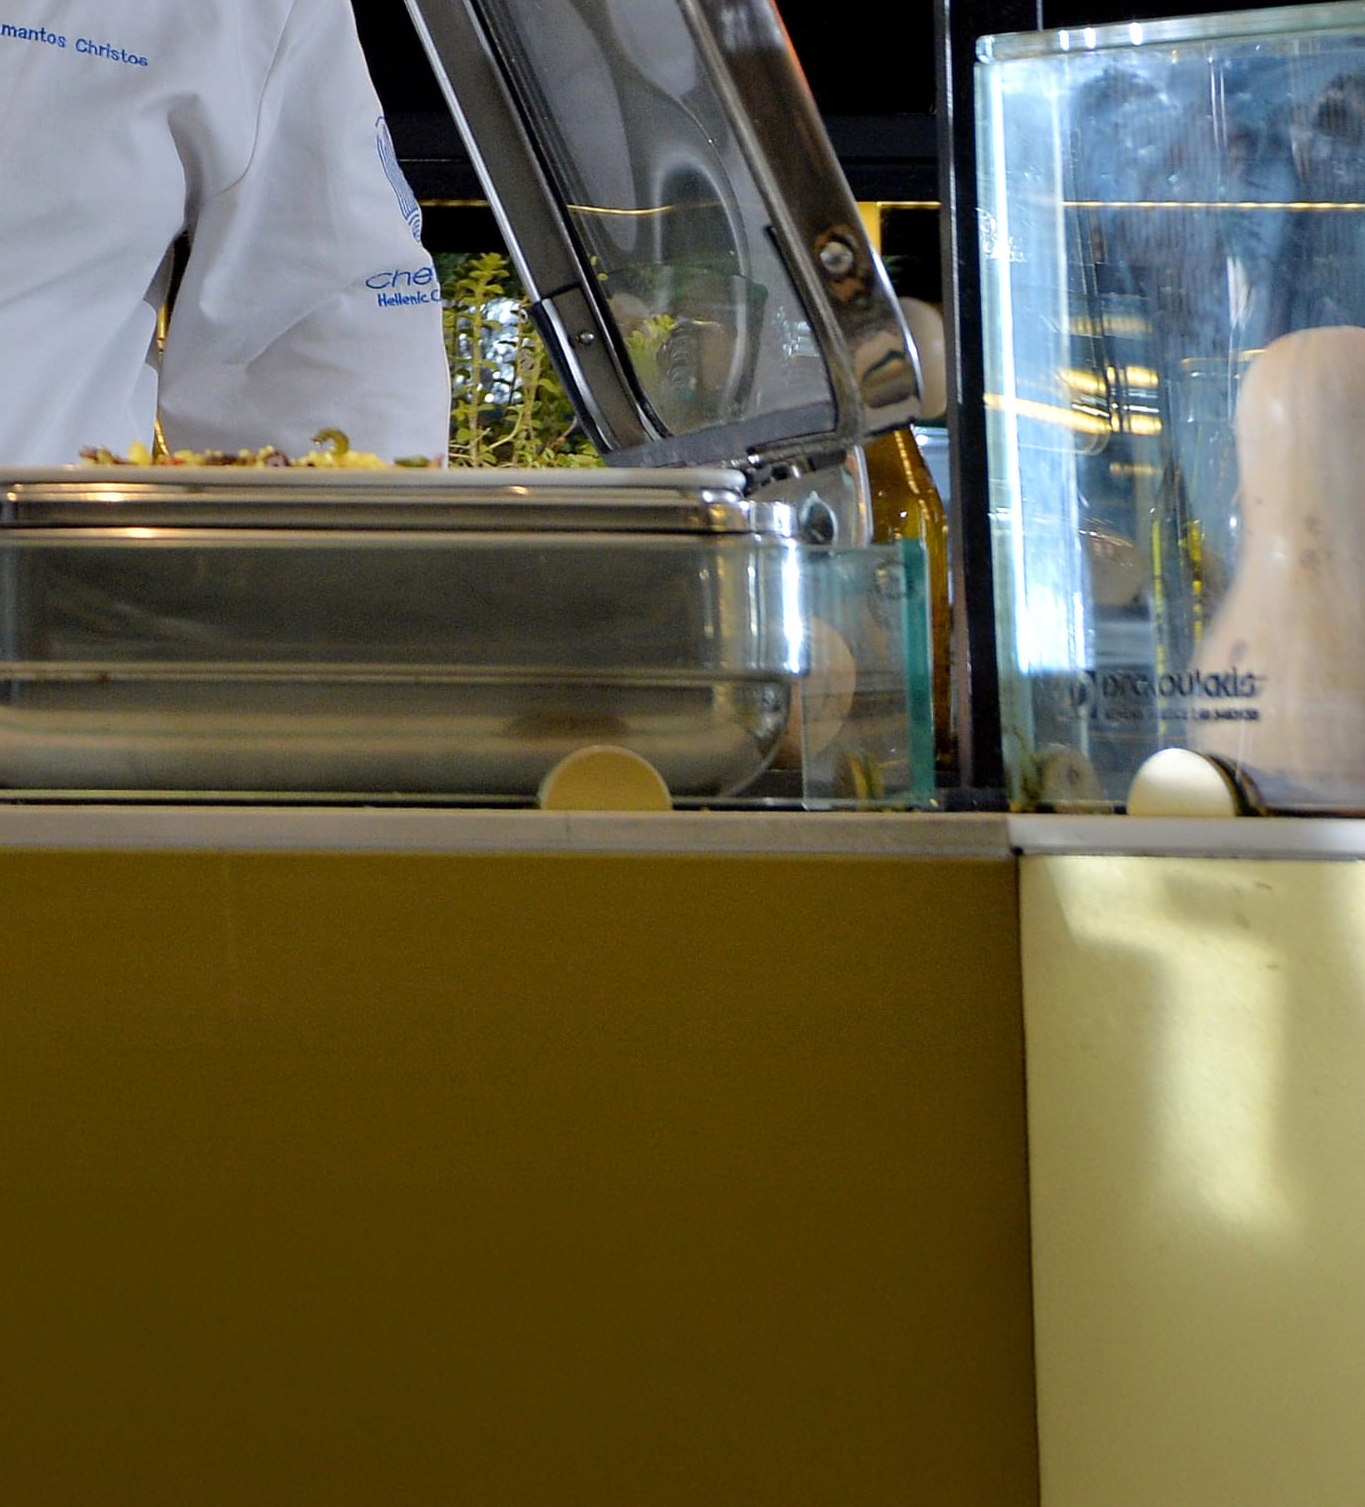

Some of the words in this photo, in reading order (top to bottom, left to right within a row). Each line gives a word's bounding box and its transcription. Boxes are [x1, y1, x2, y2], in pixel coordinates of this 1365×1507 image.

[75, 38, 149, 67] Christos
[377, 292, 429, 307] Hellenic
[430, 289, 441, 302] C
